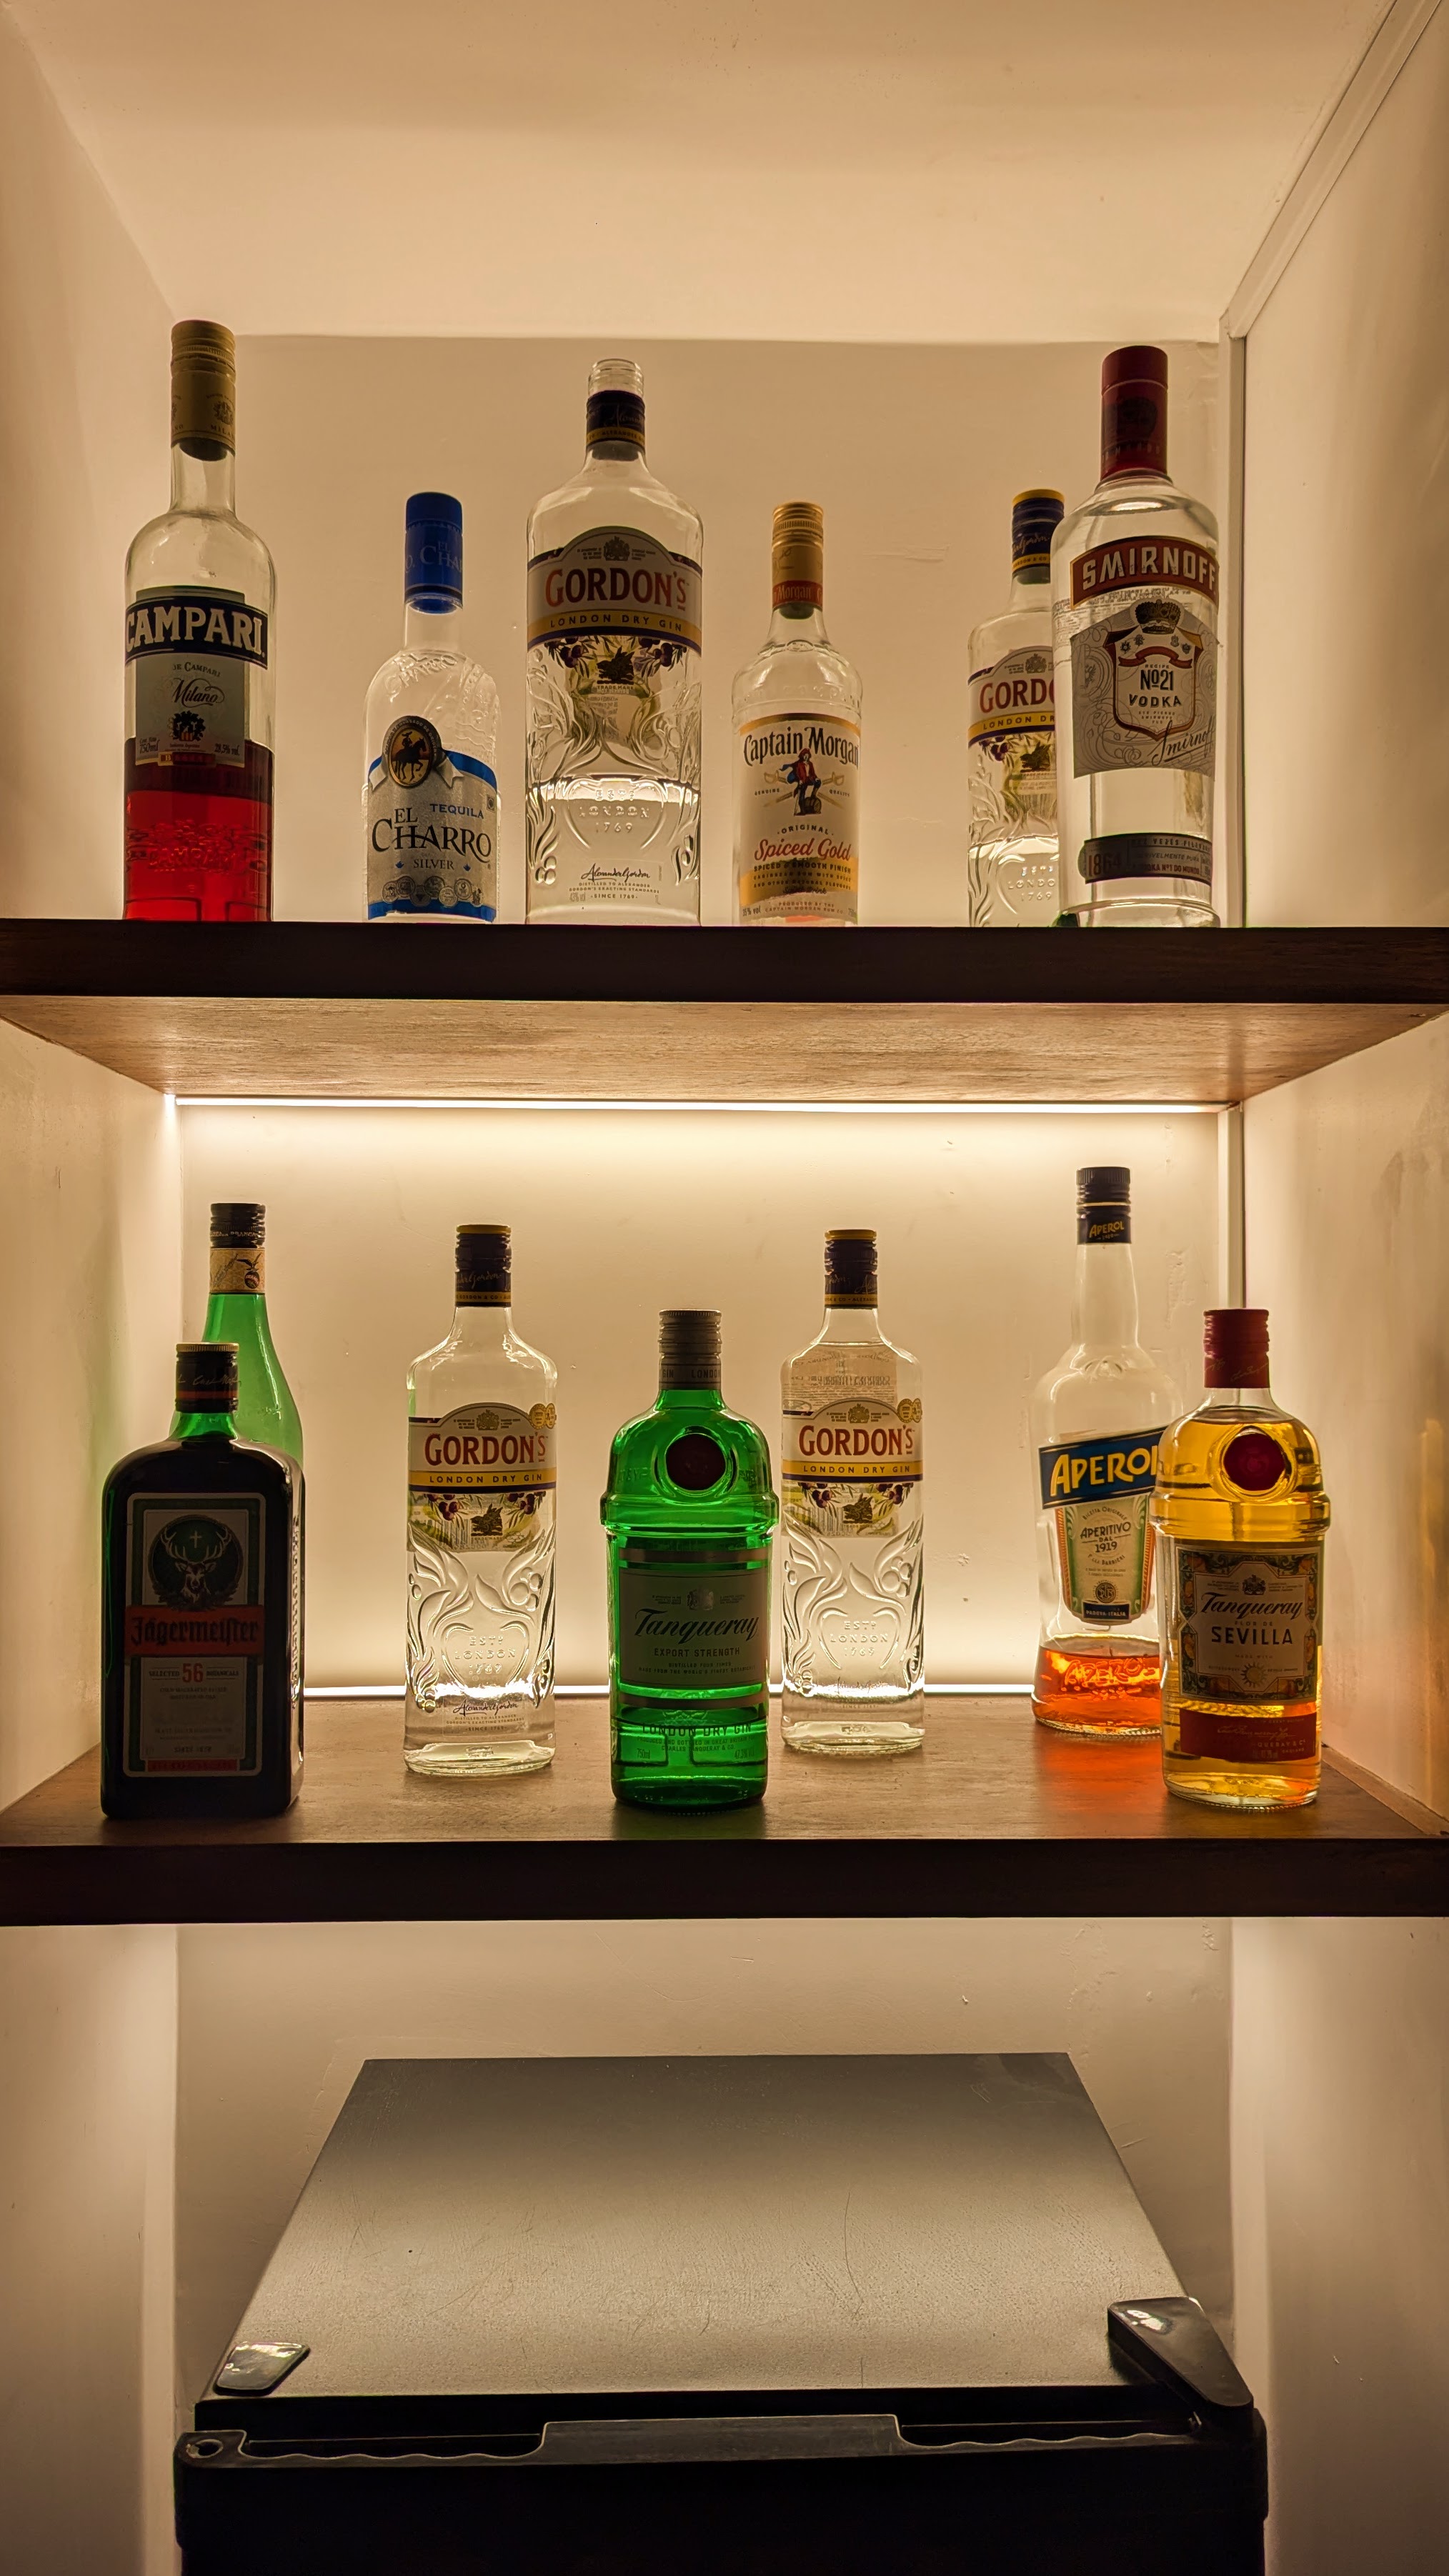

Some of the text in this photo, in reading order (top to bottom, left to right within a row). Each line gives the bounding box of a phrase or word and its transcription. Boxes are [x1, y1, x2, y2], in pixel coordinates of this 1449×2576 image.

[1082, 546, 1215, 591] SMIRNOFF
[545, 568, 687, 607] GORDON'S
[777, 584, 812, 601] Morgan
[126, 606, 262, 655] CAMPARI
[550, 614, 682, 632] LONDON DRY GIN
[184, 661, 221, 678] CAMPARI
[171, 677, 225, 708] Milano
[1129, 694, 1182, 708] VODKA
[983, 717, 1032, 730] LONDON
[744, 726, 859, 770] Captain Morgan
[394, 807, 418, 824] EL
[429, 803, 484, 819] TEQUILA
[781, 824, 829, 835] ORIGINAL
[372, 818, 492, 864] CHARRO
[754, 837, 852, 862] Spiced Gold
[413, 859, 455, 870] SILVER
[754, 862, 852, 874] SPICED SMOOTH FINISH
[1089, 1220, 1125, 1239] APEROL
[662, 1369, 674, 1379] GIN
[424, 1432, 546, 1466] GORDON'S
[799, 1424, 913, 1457] GORDON'S
[803, 1465, 855, 1474] LONDON
[492, 1474, 516, 1483] DRY
[1080, 1522, 1132, 1539] APERITIVO
[1095, 1541, 1117, 1553] 1919
[1201, 1592, 1303, 1620] Tanqueray
[634, 1608, 760, 1644] Tanqueray
[830, 1633, 888, 1643] LONDON
[1211, 1627, 1293, 1645] SEVILLA
[454, 1648, 516, 1660] LONDON
[654, 1647, 740, 1657] EXPORT STRENGTH
[182, 1662, 204, 1683] 56
[642, 1723, 751, 1737] LONDON DRY GIN
